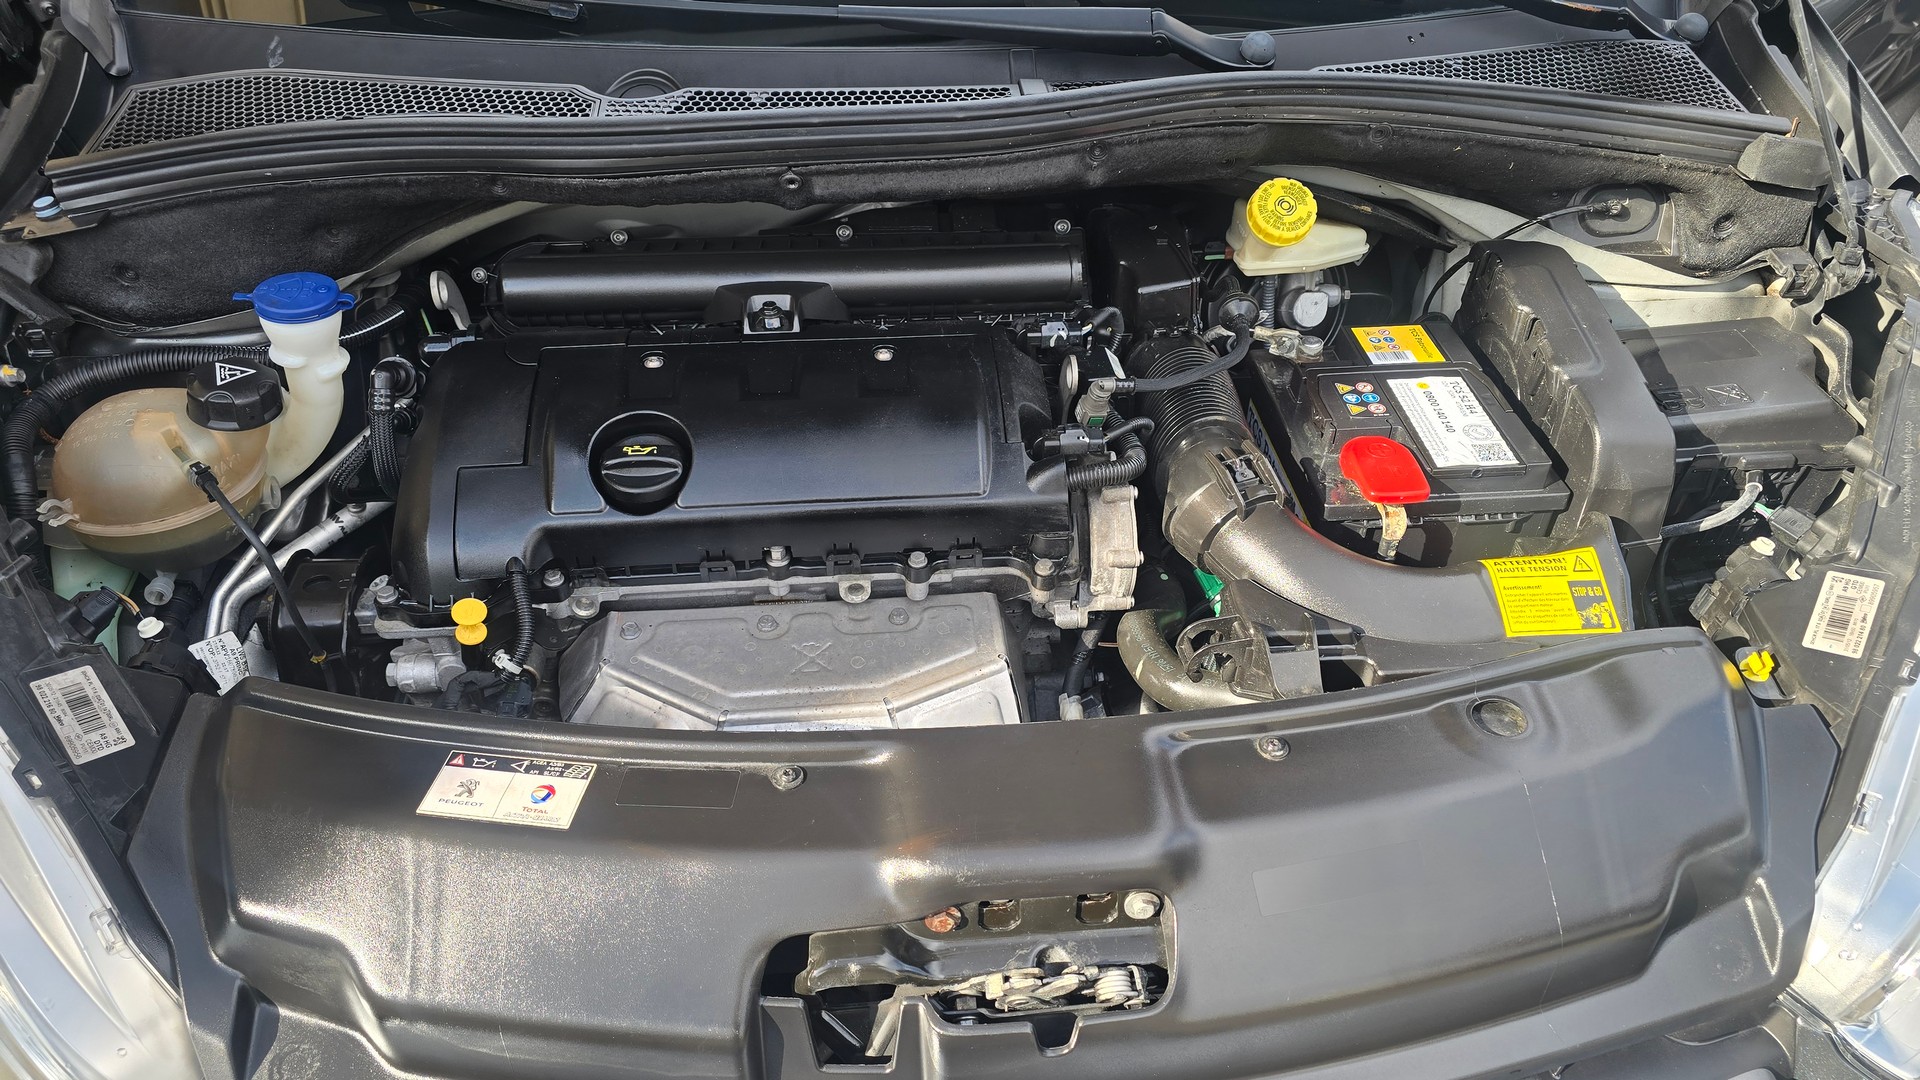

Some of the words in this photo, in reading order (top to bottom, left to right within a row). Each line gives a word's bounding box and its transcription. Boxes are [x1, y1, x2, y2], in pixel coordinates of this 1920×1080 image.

[1409, 328, 1420, 337] TCS
[1450, 381, 1464, 394] TCS
[1464, 404, 1478, 414] H4
[1423, 391, 1439, 406] 0800
[1433, 408, 1447, 419] 140
[1441, 421, 1455, 432] 140
[1494, 558, 1565, 566] ATTENTION!
[1572, 587, 1586, 596] STOP
[1587, 587, 1594, 596] &
[1593, 586, 1602, 596] GO
[1856, 631, 1864, 639] 214
[39, 690, 48, 699] 022
[43, 699, 53, 708] 216
[103, 740, 112, 748] HG
[439, 798, 483, 806] PEUGEOT
[523, 806, 548, 814] TOTAL
